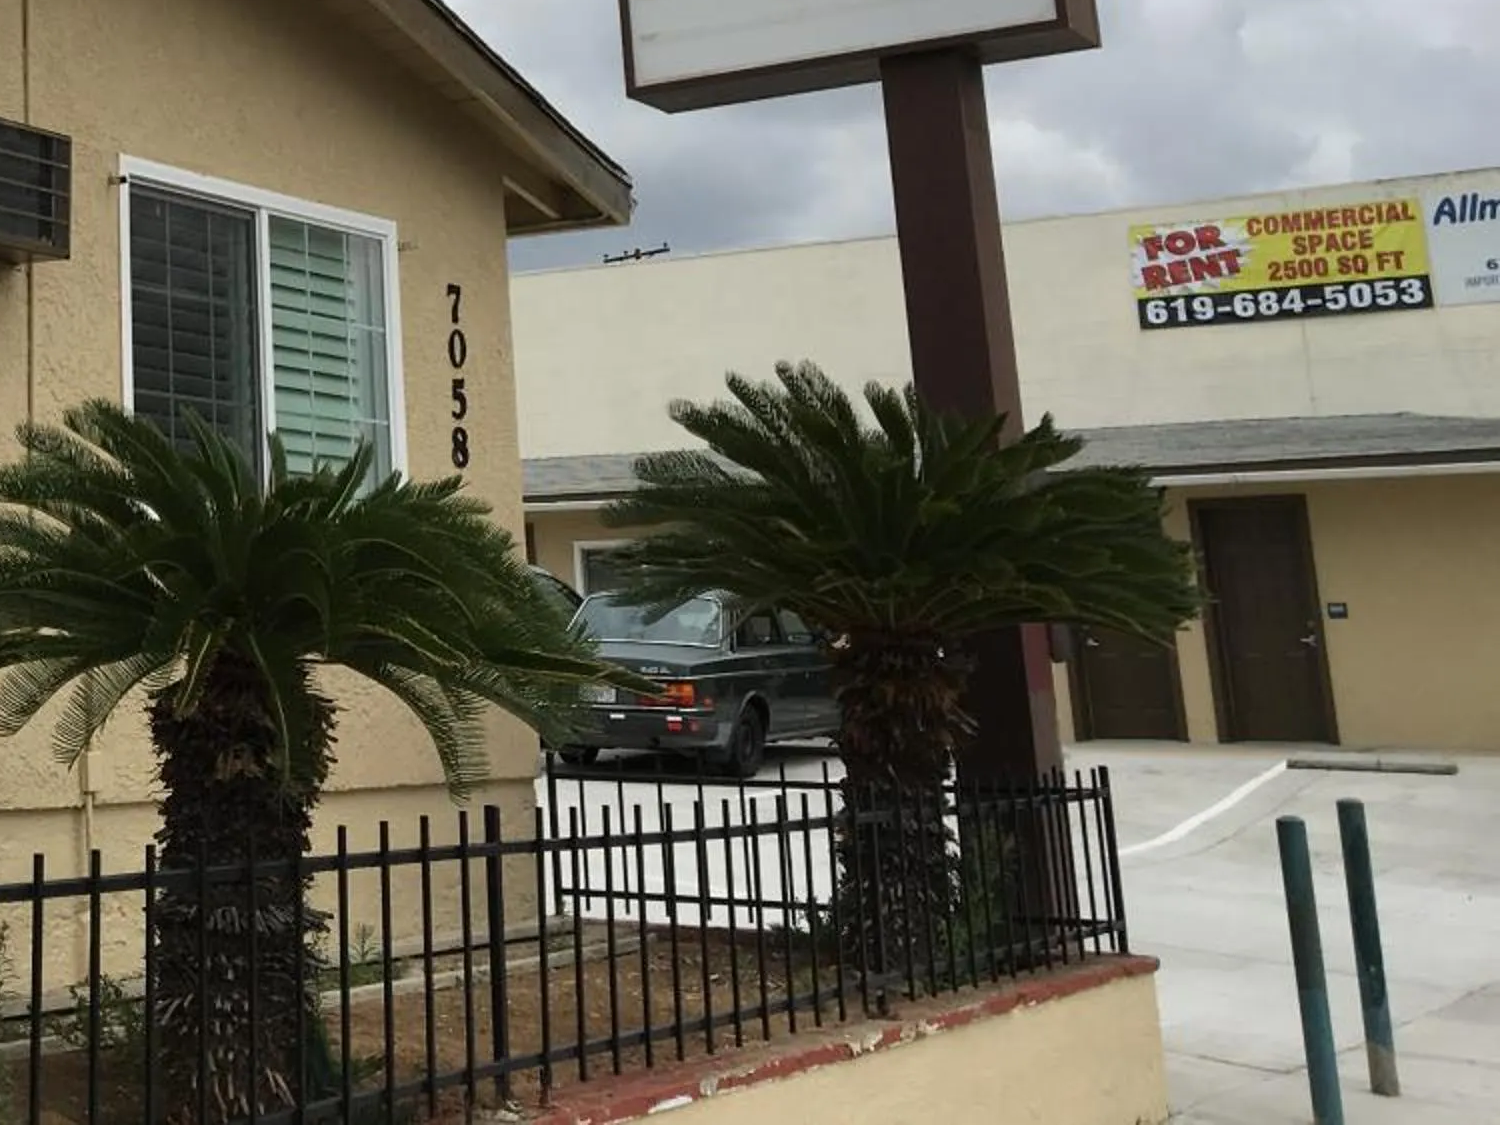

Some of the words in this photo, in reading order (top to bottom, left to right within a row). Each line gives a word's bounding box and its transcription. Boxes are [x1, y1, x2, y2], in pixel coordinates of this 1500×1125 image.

[1246, 200, 1416, 237] COMMERCIAL
[1143, 225, 1227, 261] FOR
[1292, 229, 1373, 256] SPACE
[1141, 249, 1242, 292] RENT
[1267, 257, 1329, 282] 2500
[1337, 254, 1369, 276] SQ
[1376, 250, 1405, 272] FT
[1145, 278, 1425, 325] 619-684-5053
[446, 282, 470, 470] 7058
